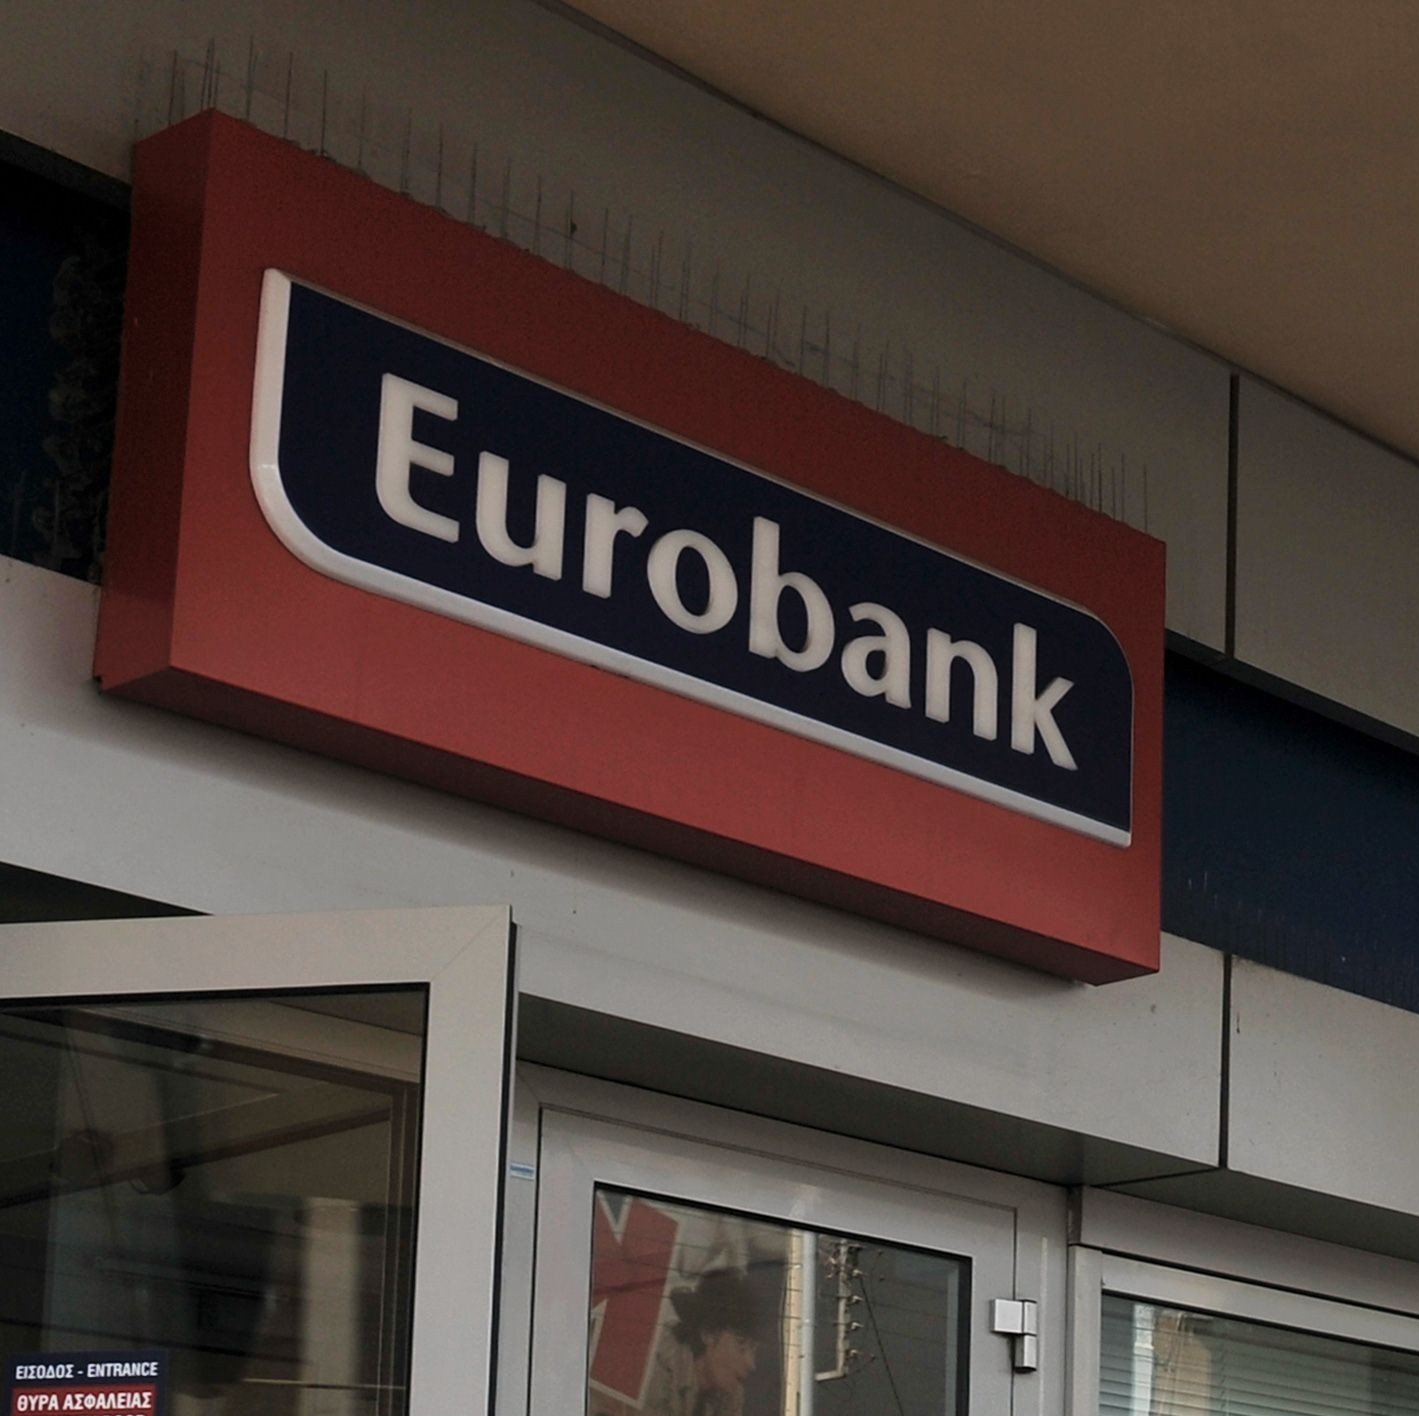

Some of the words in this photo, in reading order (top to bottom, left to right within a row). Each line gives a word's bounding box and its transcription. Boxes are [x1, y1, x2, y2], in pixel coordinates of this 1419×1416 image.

[375, 371, 1078, 773] Eurobank
[15, 1363, 75, 1380] ΕΙΣΟΔΟΣ
[87, 1361, 159, 1379] ENTRANCE
[17, 1392, 59, 1412] ΘΥΡΑ
[62, 1391, 153, 1411] ΑΣΦΑΛΕΙΑΣ
